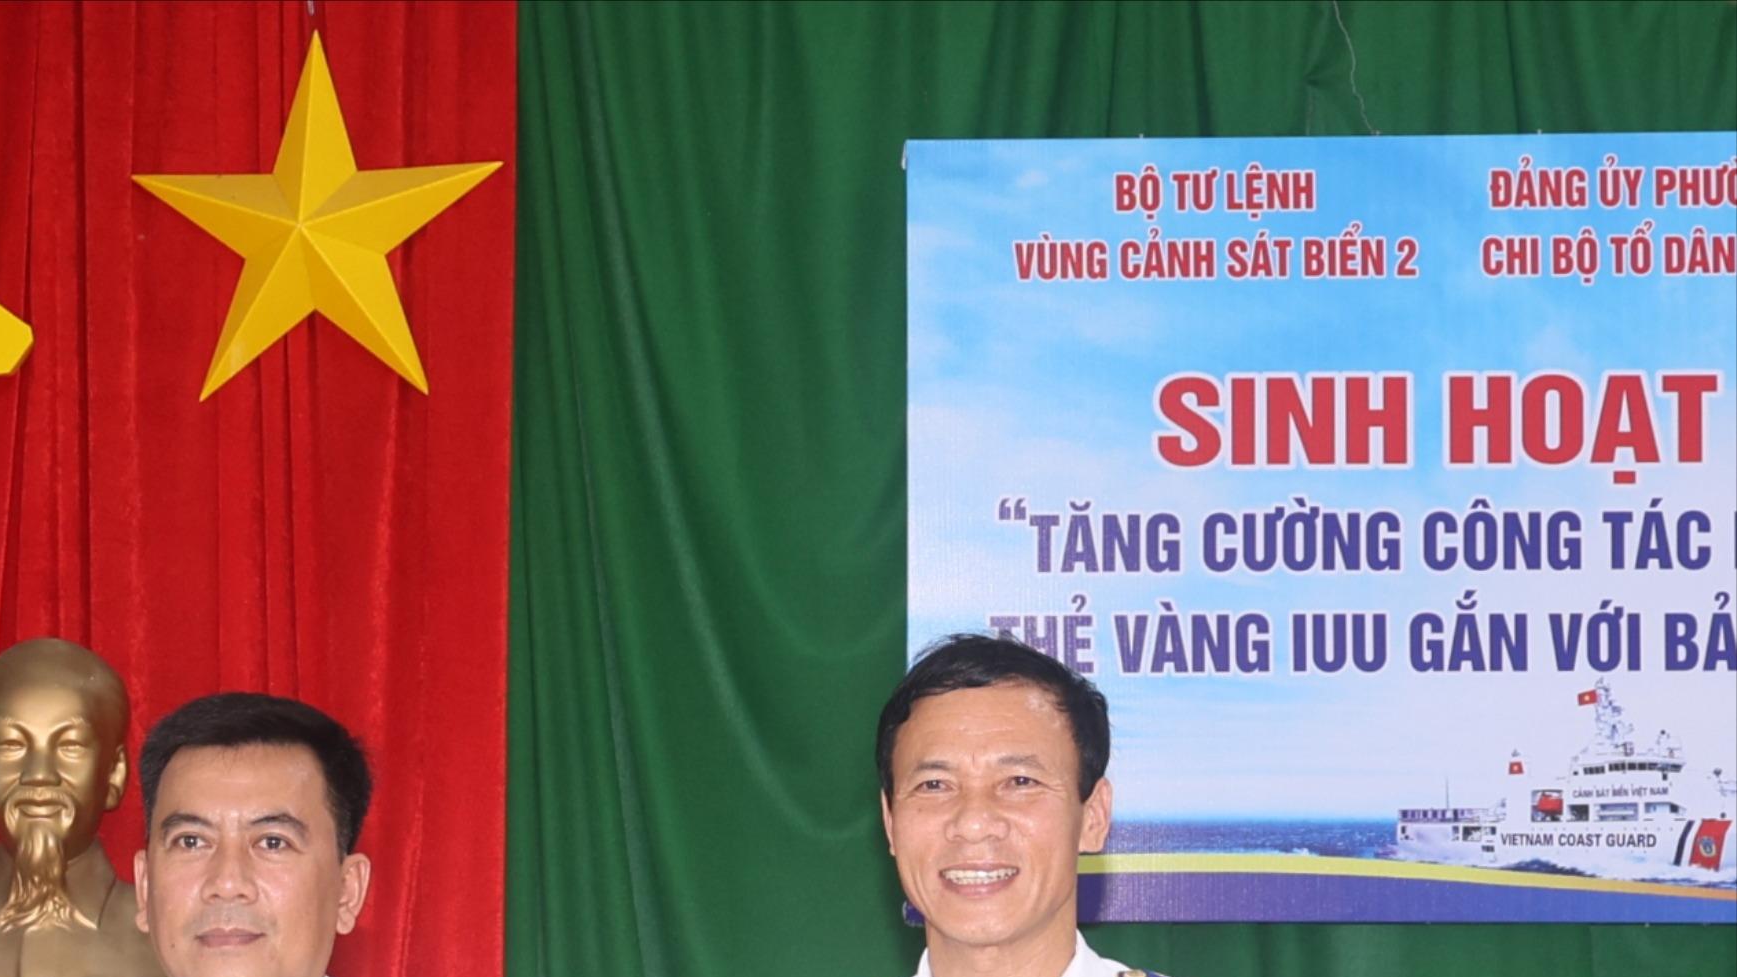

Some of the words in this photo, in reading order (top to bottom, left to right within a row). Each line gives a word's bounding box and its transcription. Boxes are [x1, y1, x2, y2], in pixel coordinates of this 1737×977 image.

[1115, 165, 1161, 220] BỘ
[1173, 168, 1219, 211] TƯ
[1227, 164, 1315, 218] LỆNH
[1490, 156, 1587, 208] ĐẢNG
[1599, 156, 1643, 207] ỦY
[1015, 234, 1107, 280] VÙNG
[1121, 228, 1215, 279] CẢNH
[1228, 232, 1292, 278] SÁT
[1305, 223, 1385, 277] BIỂN
[1397, 239, 1417, 276] 2
[1483, 237, 1539, 276] CHI
[1553, 228, 1598, 284] BỘ
[1610, 220, 1653, 275] TỔ
[1665, 227, 1736, 274] DÂN
[1158, 375, 1409, 468] SINH
[1449, 374, 1719, 485] HOẠT
[1203, 497, 1401, 572] CƯỜNG
[1423, 498, 1582, 571] CÔNG
[1602, 498, 1711, 571] TÁC
[1114, 602, 1270, 673] VÀNG
[1292, 613, 1387, 673] IUU
[1409, 589, 1528, 673] GẮN
[1548, 599, 1641, 672] VỚI
[1500, 833, 1554, 846] VIETNAM
[1558, 833, 1603, 847] COAST
[1606, 833, 1657, 848] GUARD
